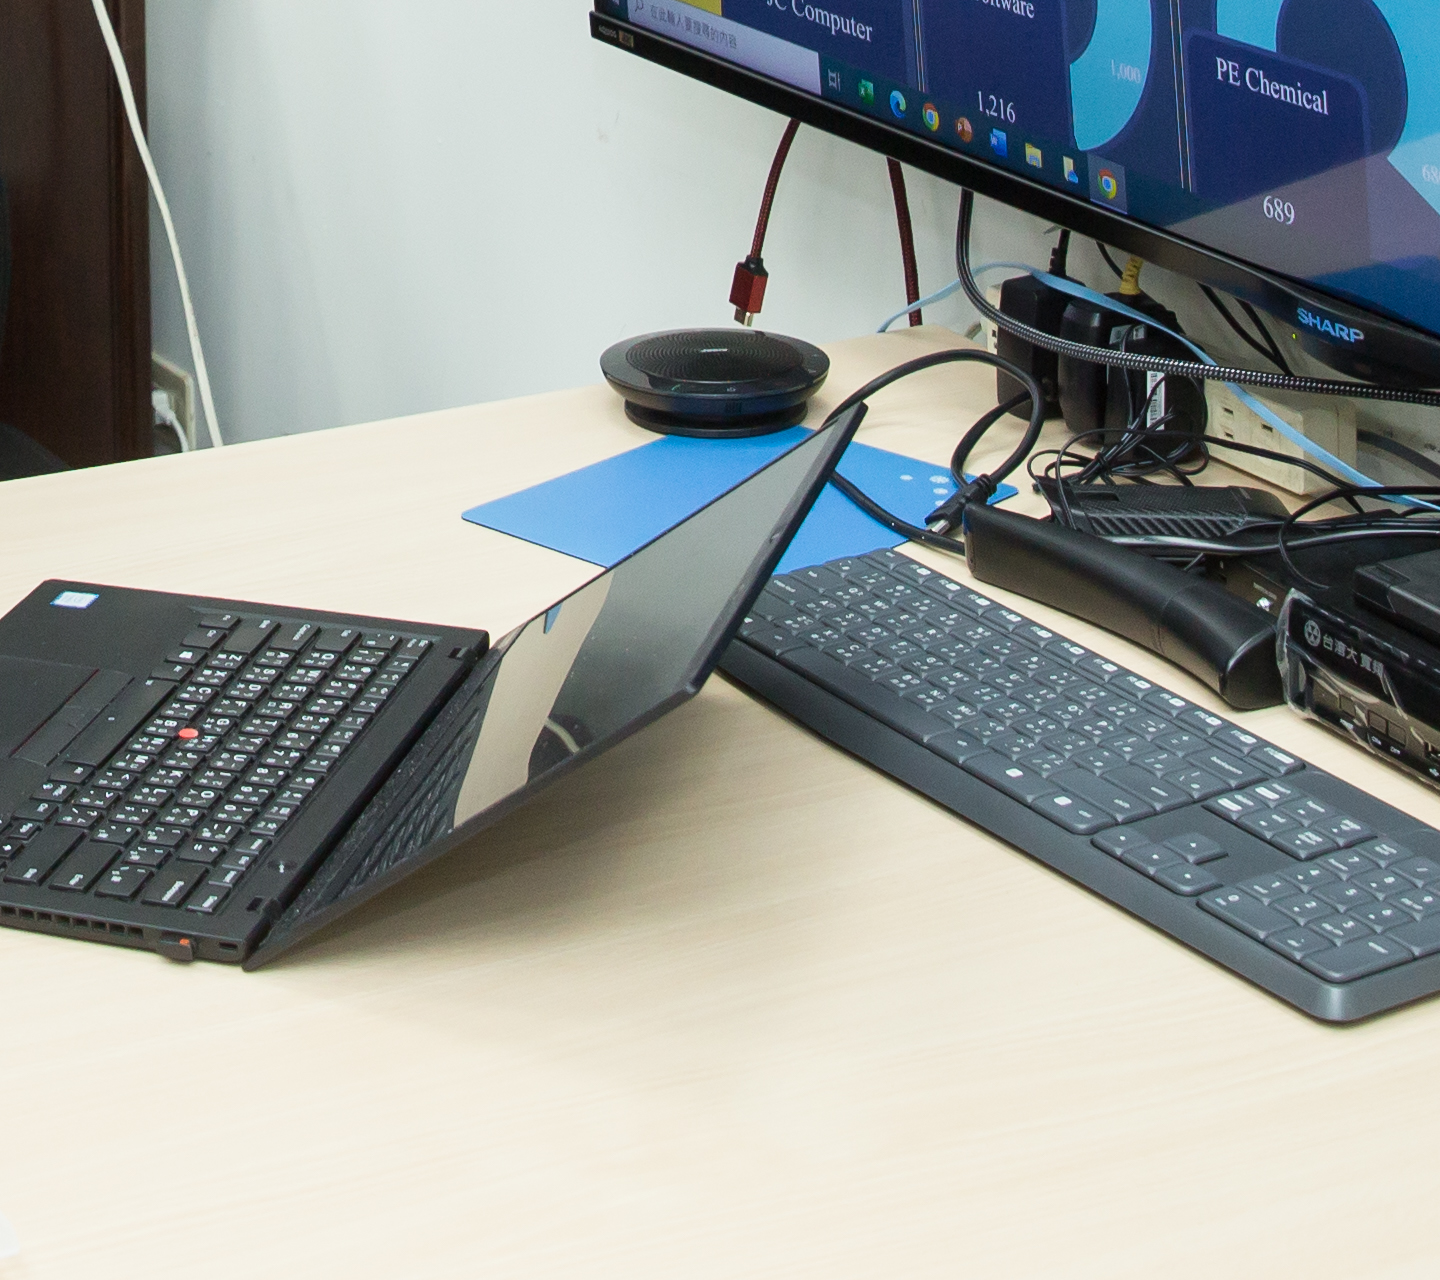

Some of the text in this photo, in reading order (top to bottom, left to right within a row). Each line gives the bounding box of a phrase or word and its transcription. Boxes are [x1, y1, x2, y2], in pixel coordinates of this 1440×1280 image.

[1215, 57, 1329, 116] PE Chemical
[977, 90, 1016, 124] 1,216
[1262, 194, 1295, 226] 689
[1296, 307, 1365, 343] SHARP
